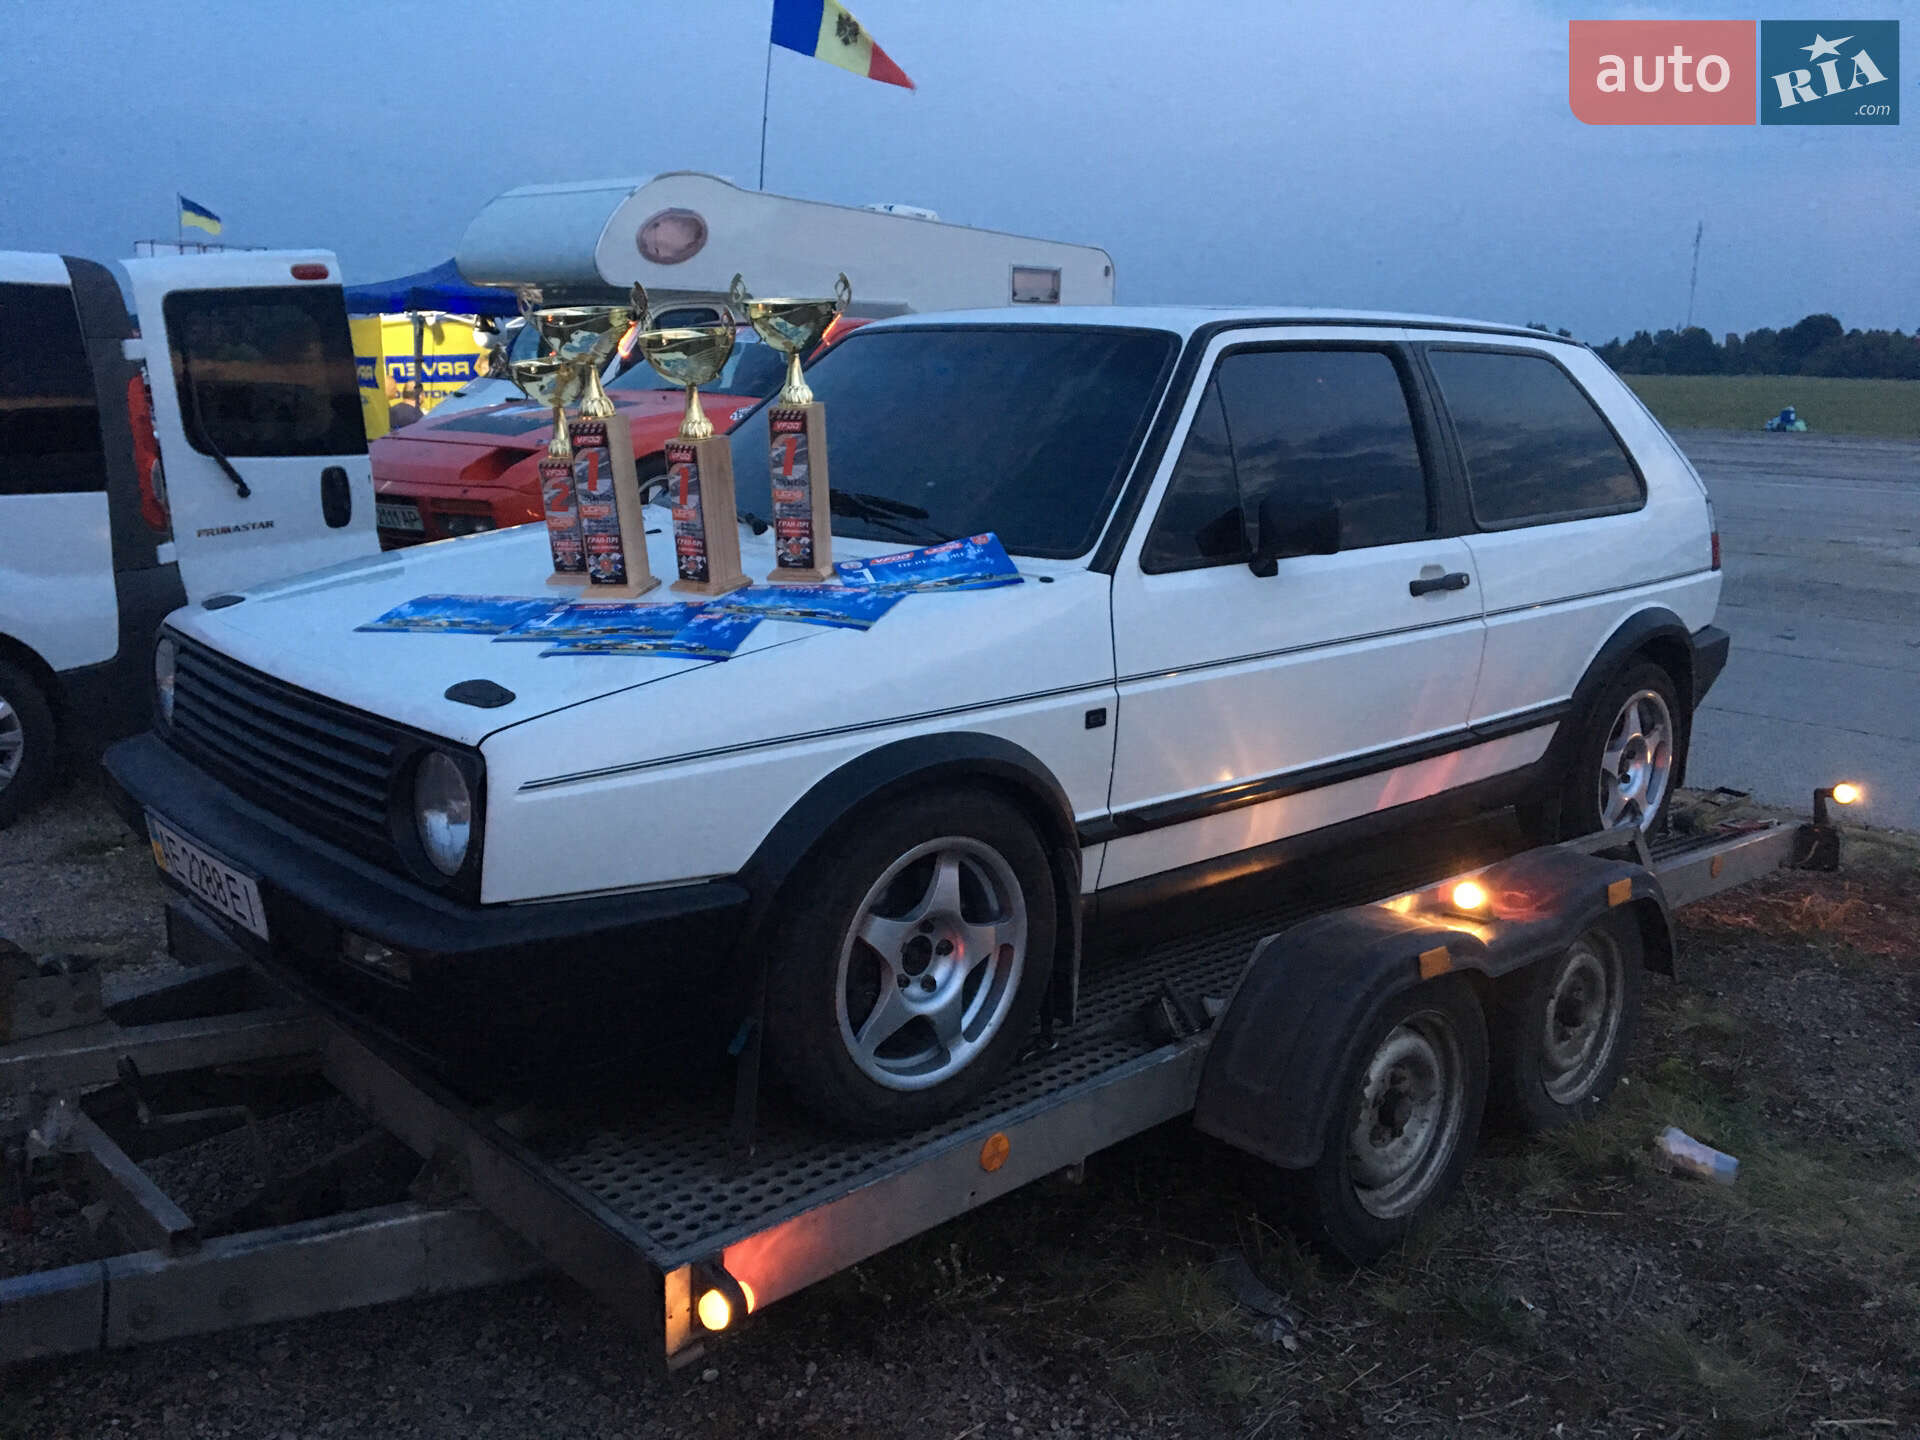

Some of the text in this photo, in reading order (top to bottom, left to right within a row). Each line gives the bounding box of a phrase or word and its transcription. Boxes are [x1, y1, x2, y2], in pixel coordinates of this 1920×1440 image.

[587, 451, 600, 492] 1
[782, 437, 798, 477] 1
[552, 482, 571, 512] 2
[679, 467, 690, 506] 1
[196, 520, 275, 538] PRIMASTAR
